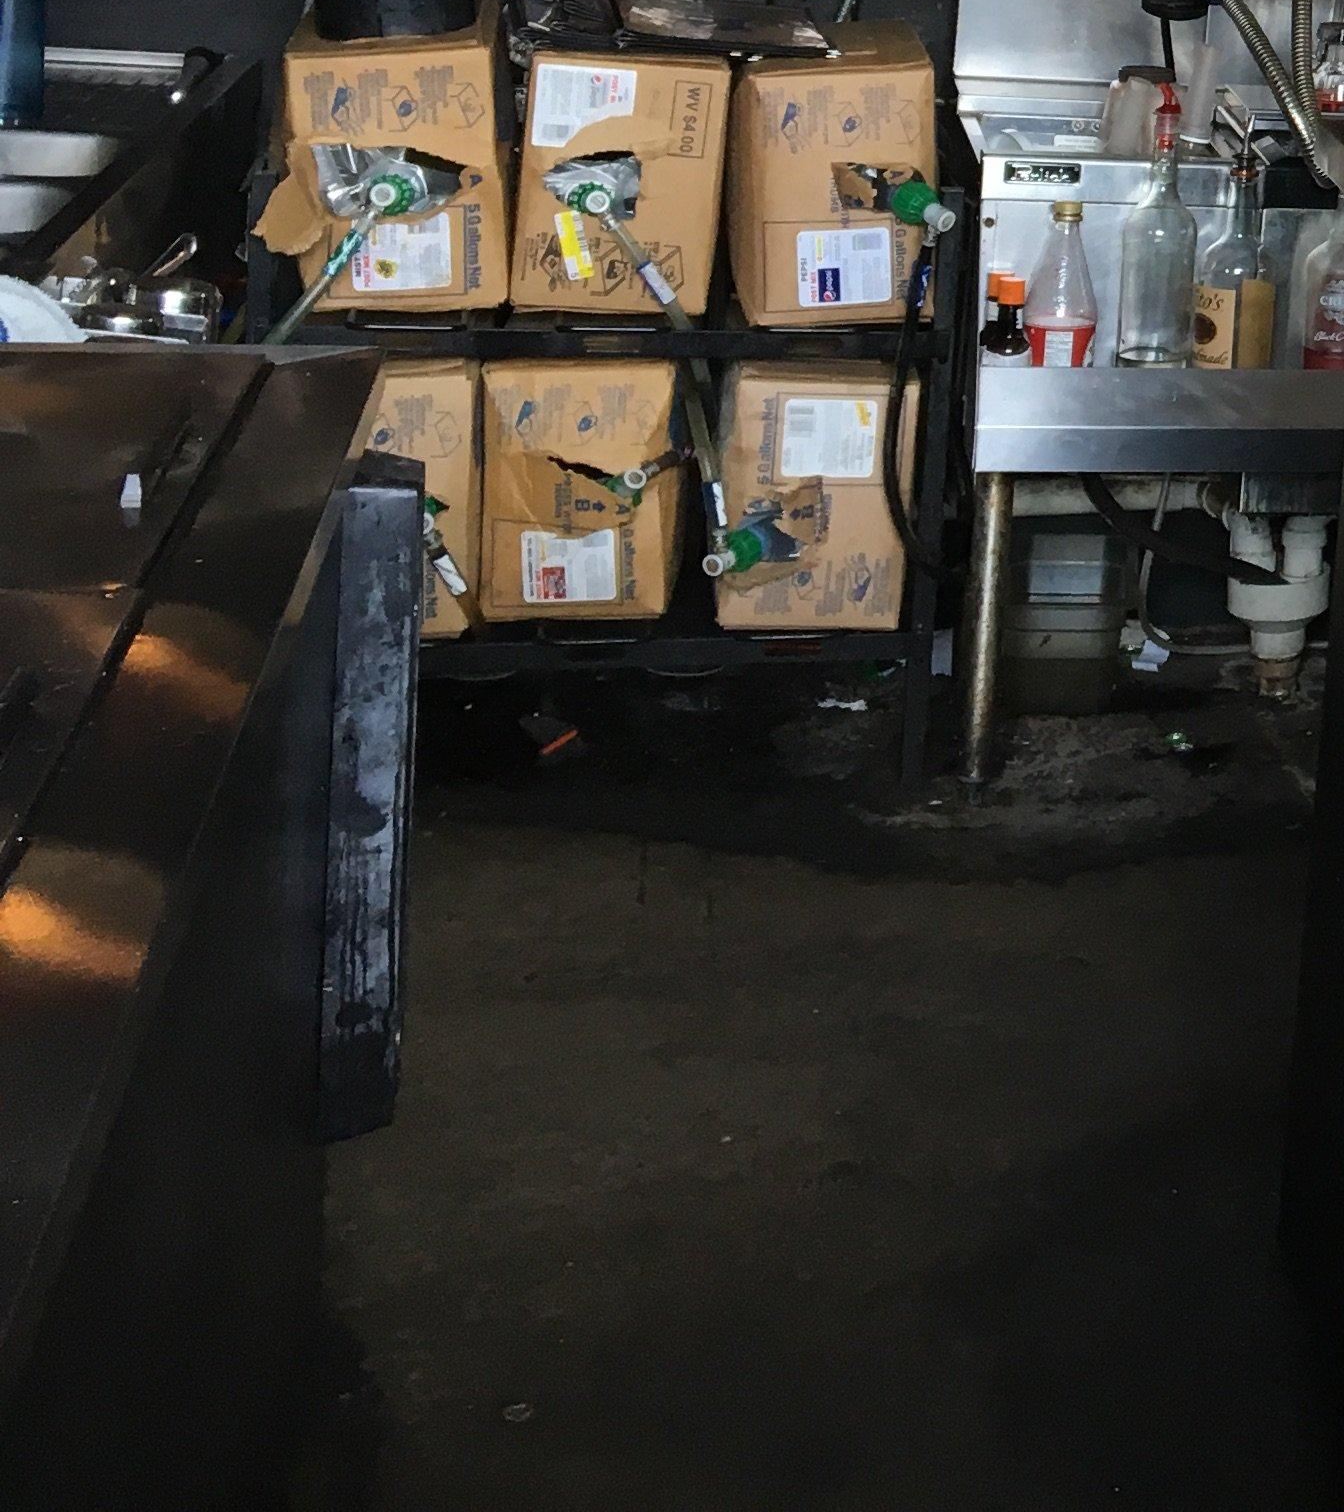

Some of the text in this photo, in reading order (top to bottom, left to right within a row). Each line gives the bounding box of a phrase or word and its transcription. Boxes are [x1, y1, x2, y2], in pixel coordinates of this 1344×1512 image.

[467, 215, 482, 264] Gallons
[467, 265, 482, 290] Net
[757, 423, 774, 473] Gallons
